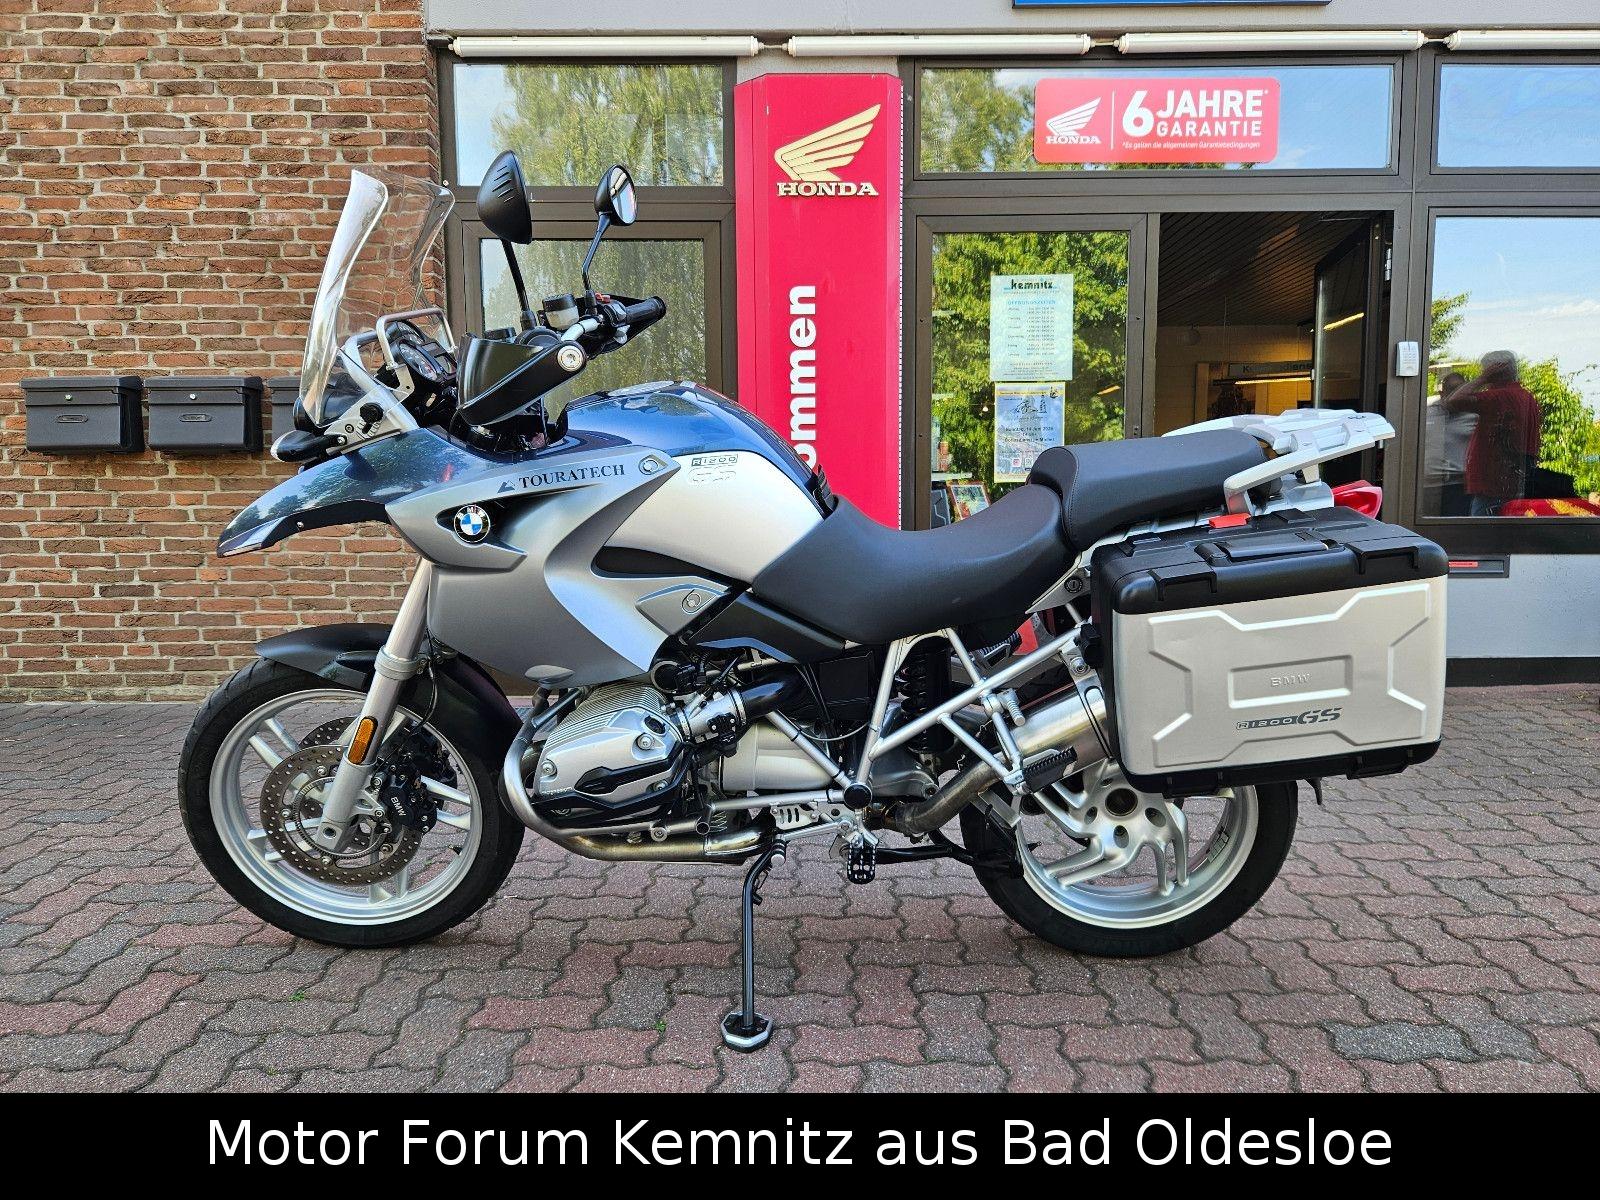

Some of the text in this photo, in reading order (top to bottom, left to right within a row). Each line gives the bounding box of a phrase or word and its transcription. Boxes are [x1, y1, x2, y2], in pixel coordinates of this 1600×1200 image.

[1122, 90, 1154, 137] 6
[1156, 120, 1262, 137] GARANTIE
[1045, 135, 1102, 145] HONDA
[777, 182, 879, 197] HONDA
[1011, 278, 1053, 290] kemnitz
[519, 464, 625, 489] TOURATECH
[1270, 673, 1310, 687] BMW
[390, 796, 407, 816] BMW
